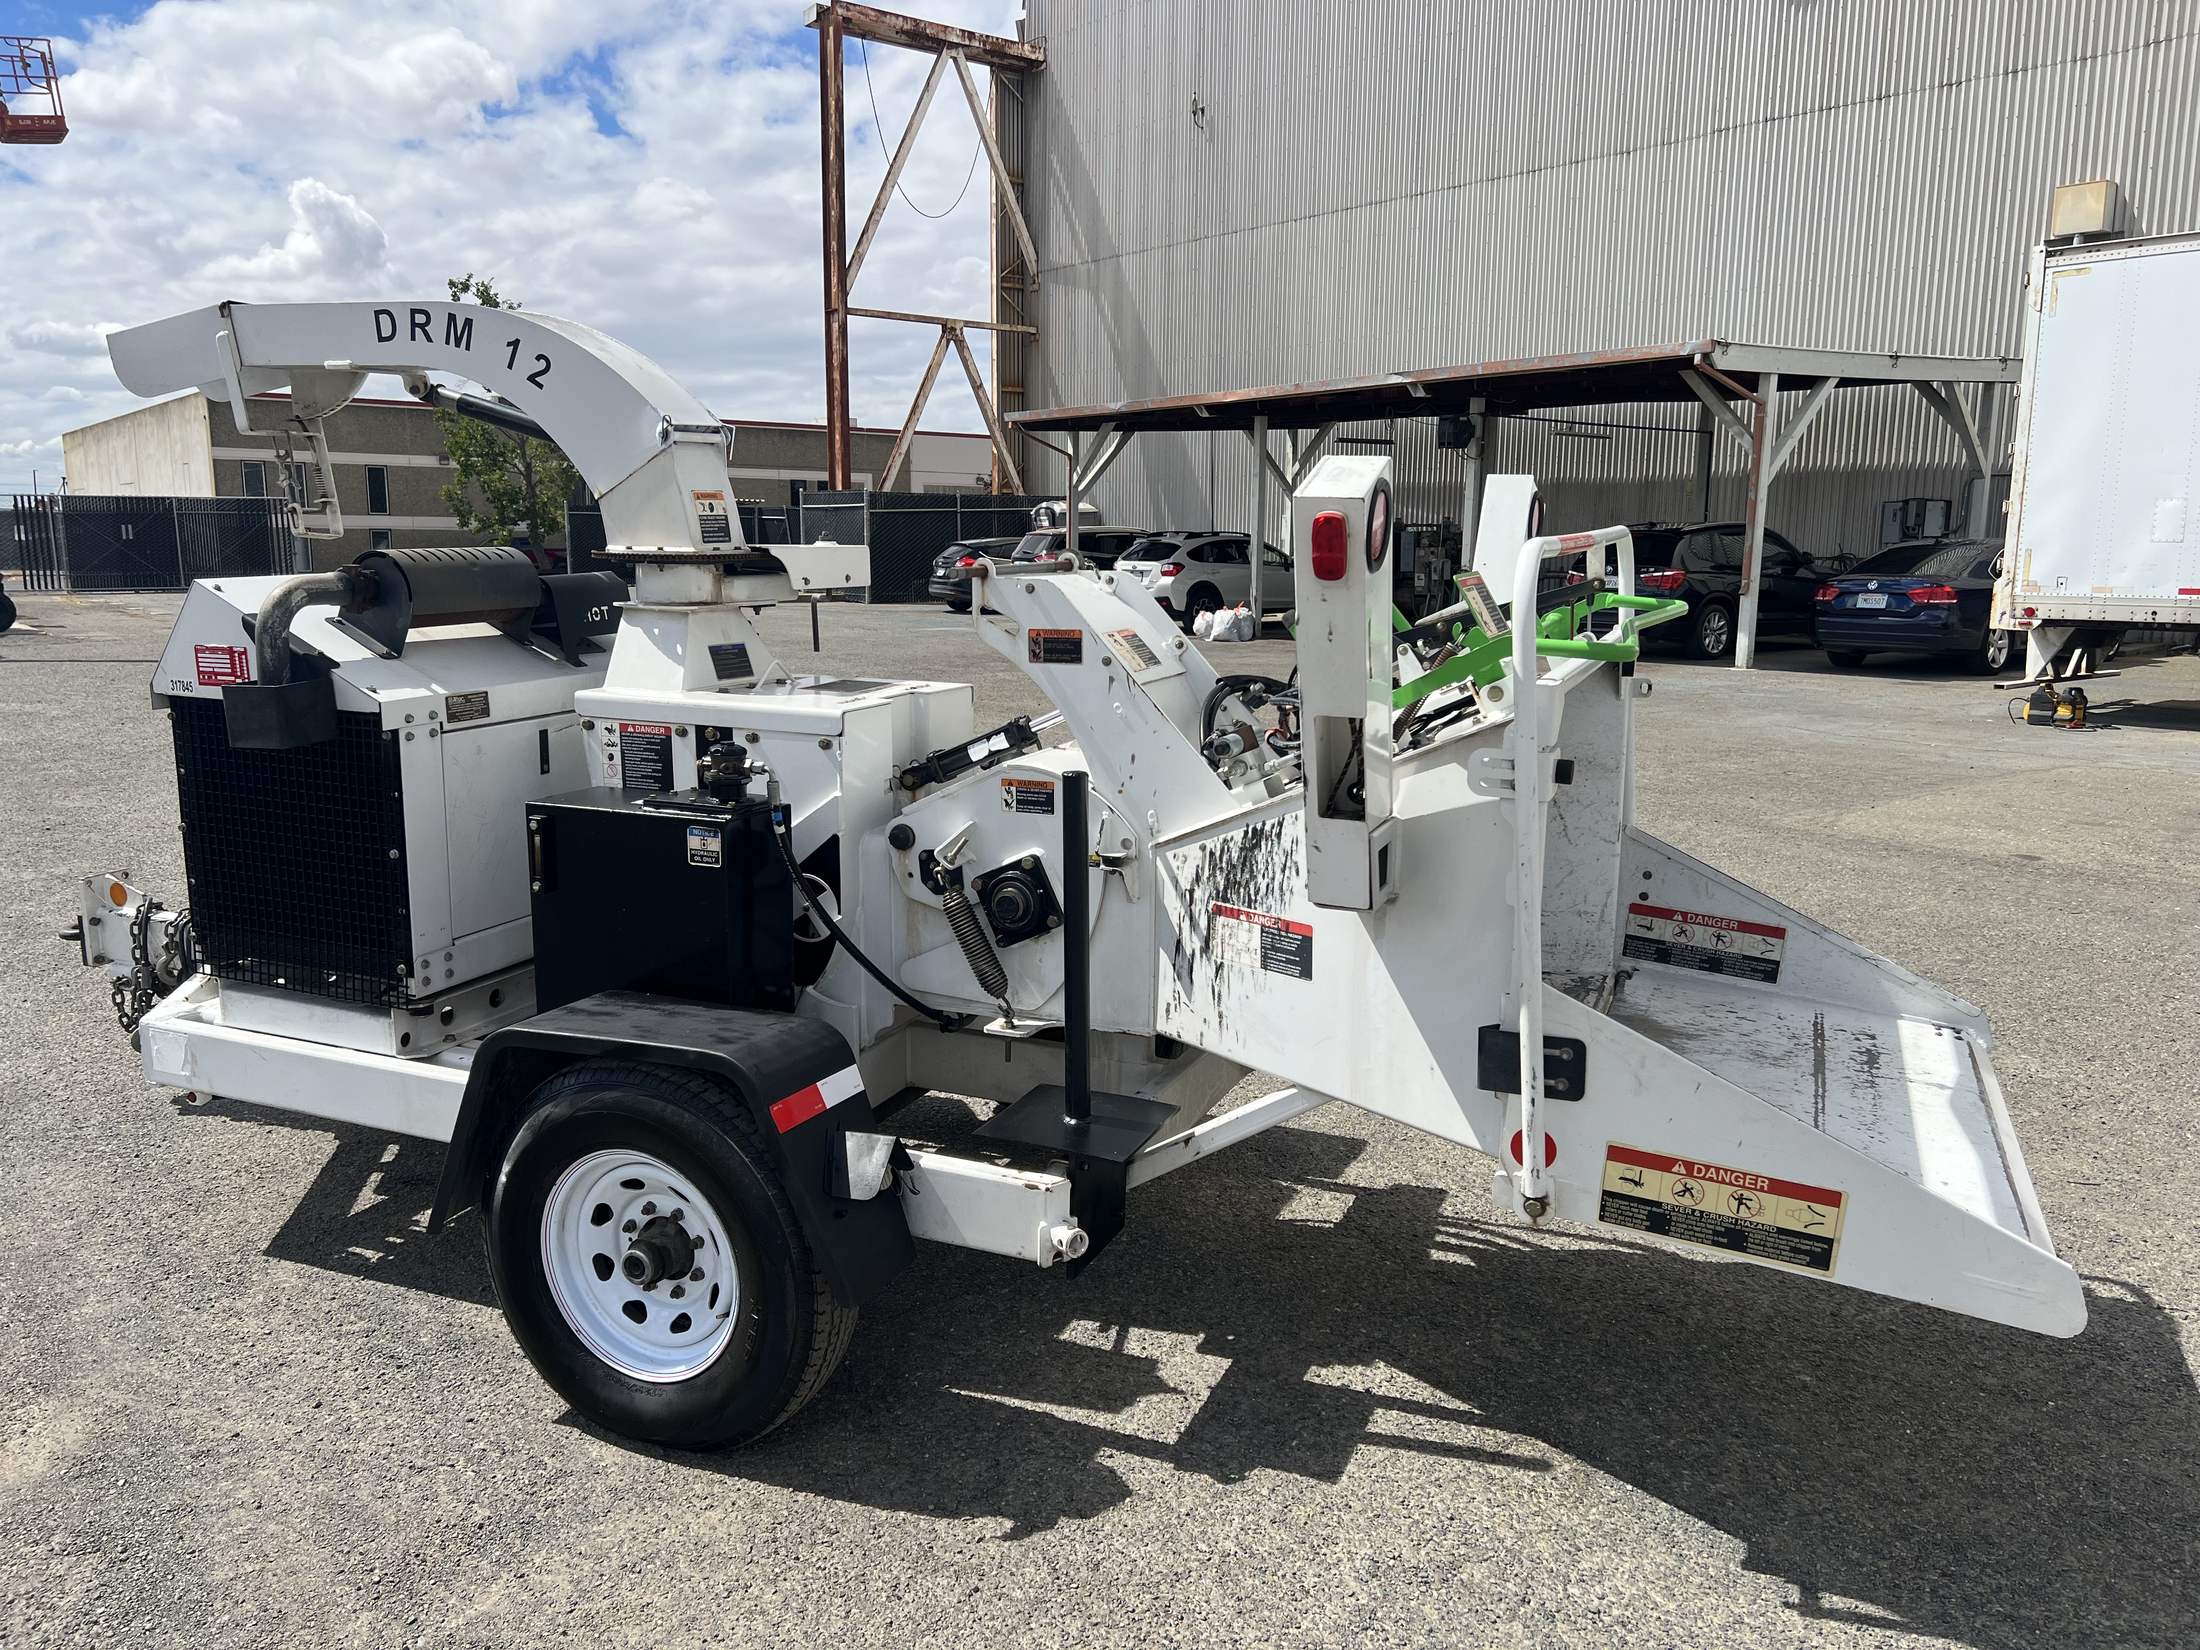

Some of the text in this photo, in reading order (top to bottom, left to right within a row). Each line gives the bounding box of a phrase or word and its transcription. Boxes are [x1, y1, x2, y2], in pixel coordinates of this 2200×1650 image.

[374, 308, 551, 390] DRM 12
[170, 680, 193, 693] 317845
[635, 725, 665, 734] DANGER
[1017, 780, 1048, 788] WARNING
[1249, 913, 1282, 929] DANGER
[1687, 913, 1739, 930] DANGER
[1693, 1164, 1769, 1191] DANGER
[1662, 1203, 1777, 1234] SEVER & CRUSH HAZARD
